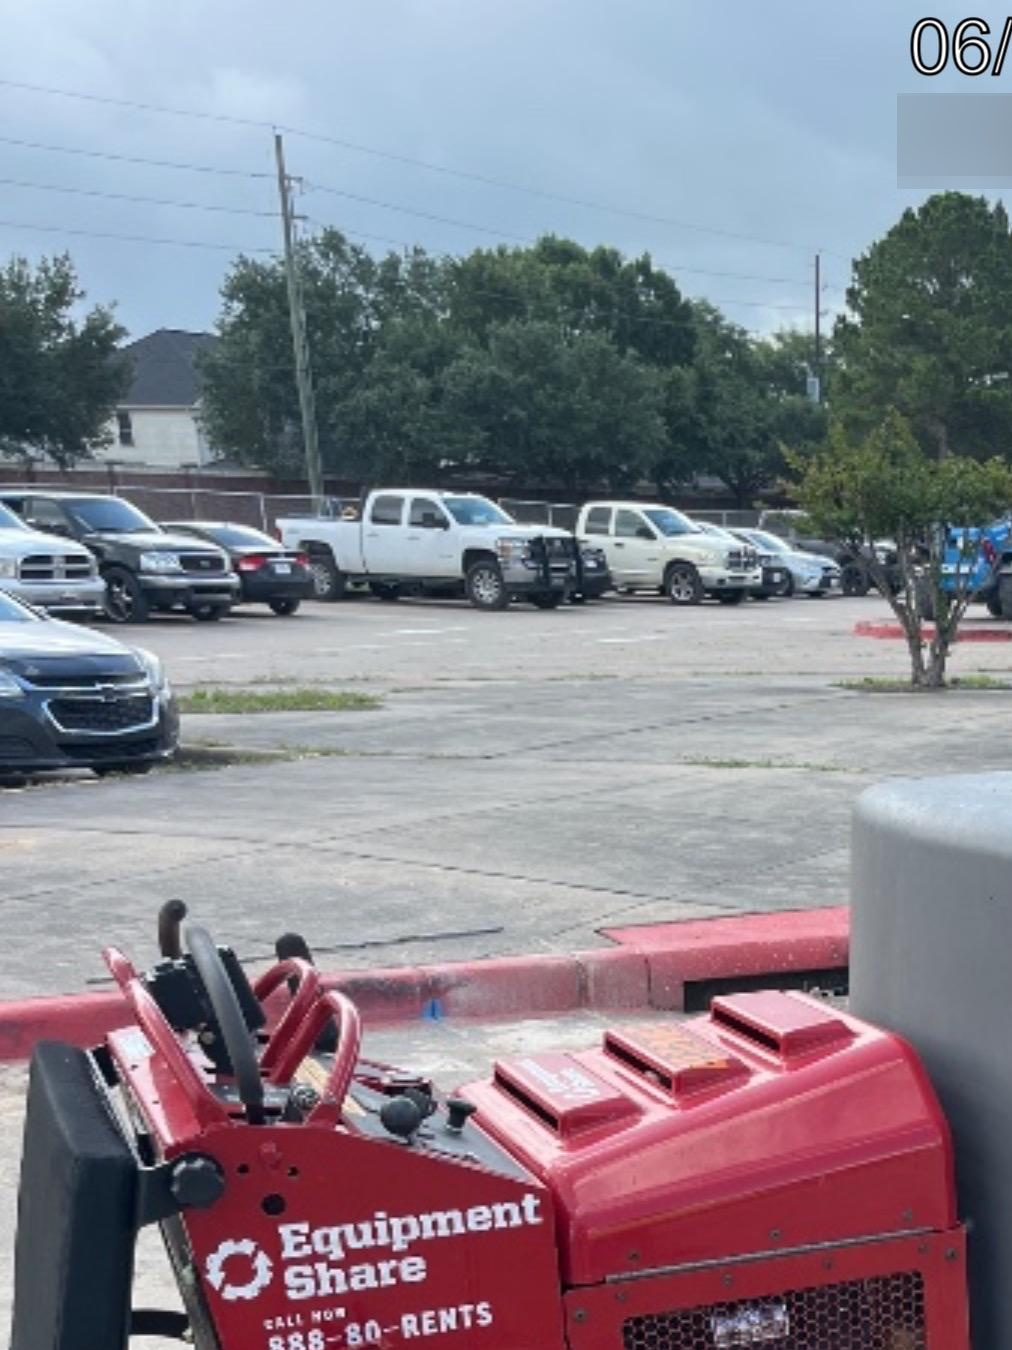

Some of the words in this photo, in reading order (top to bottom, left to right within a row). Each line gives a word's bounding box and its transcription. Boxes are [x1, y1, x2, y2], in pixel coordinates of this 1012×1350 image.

[278, 1193, 544, 1260] Equipment
[284, 1255, 427, 1300] Share
[263, 1313, 304, 1330] CALL
[311, 1307, 346, 1323] NOW
